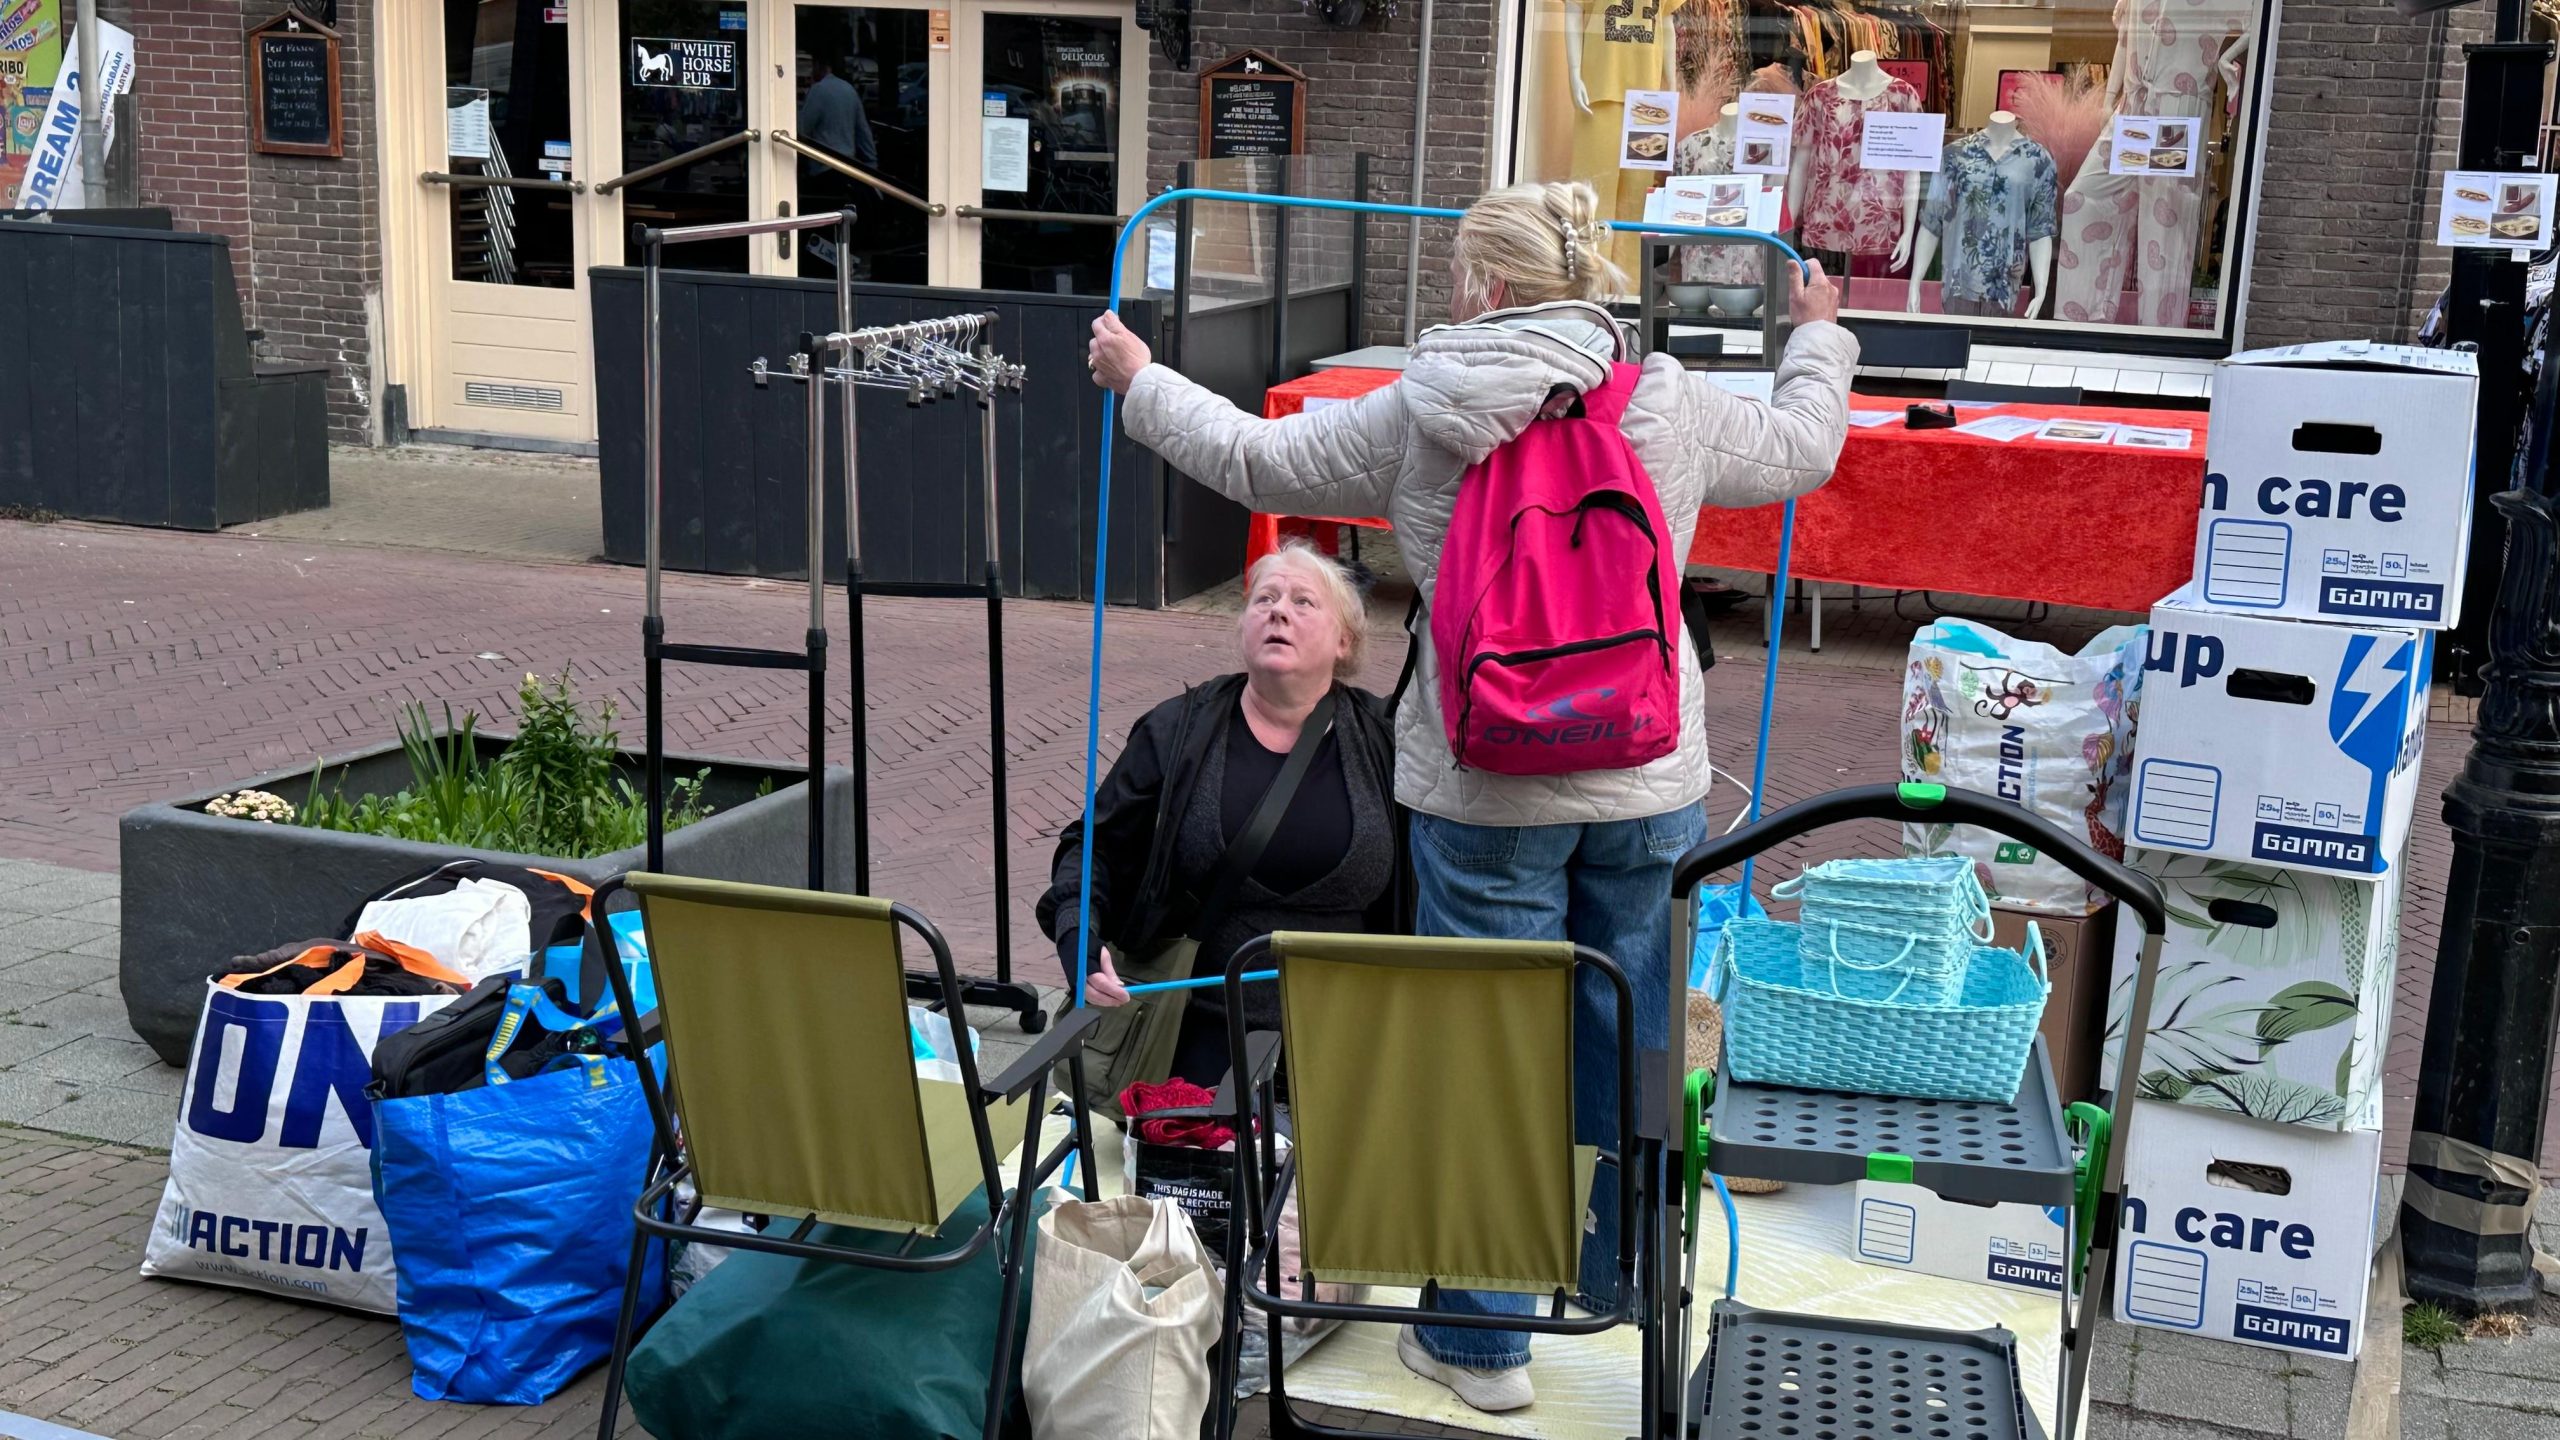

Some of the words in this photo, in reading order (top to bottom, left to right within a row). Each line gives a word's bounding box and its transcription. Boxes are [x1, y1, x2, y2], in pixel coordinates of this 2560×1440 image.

[682, 42, 733, 58] WHITE
[1061, 53, 1105, 61] DELICIOUS
[682, 57, 732, 72] HORSE
[682, 71, 712, 86] PUB
[2257, 475, 2406, 523] care
[2144, 629, 2224, 688] up
[1998, 725, 2025, 809] CTION
[1153, 1183, 1171, 1194] THIS
[1172, 1185, 1188, 1197] BAG
[1189, 1187, 1198, 1198] IS
[1198, 1189, 1224, 1200] MADE
[1186, 1198, 1232, 1209] RECYCLED
[189, 1210, 368, 1273] ACTION
[2174, 1206, 2315, 1260] care
